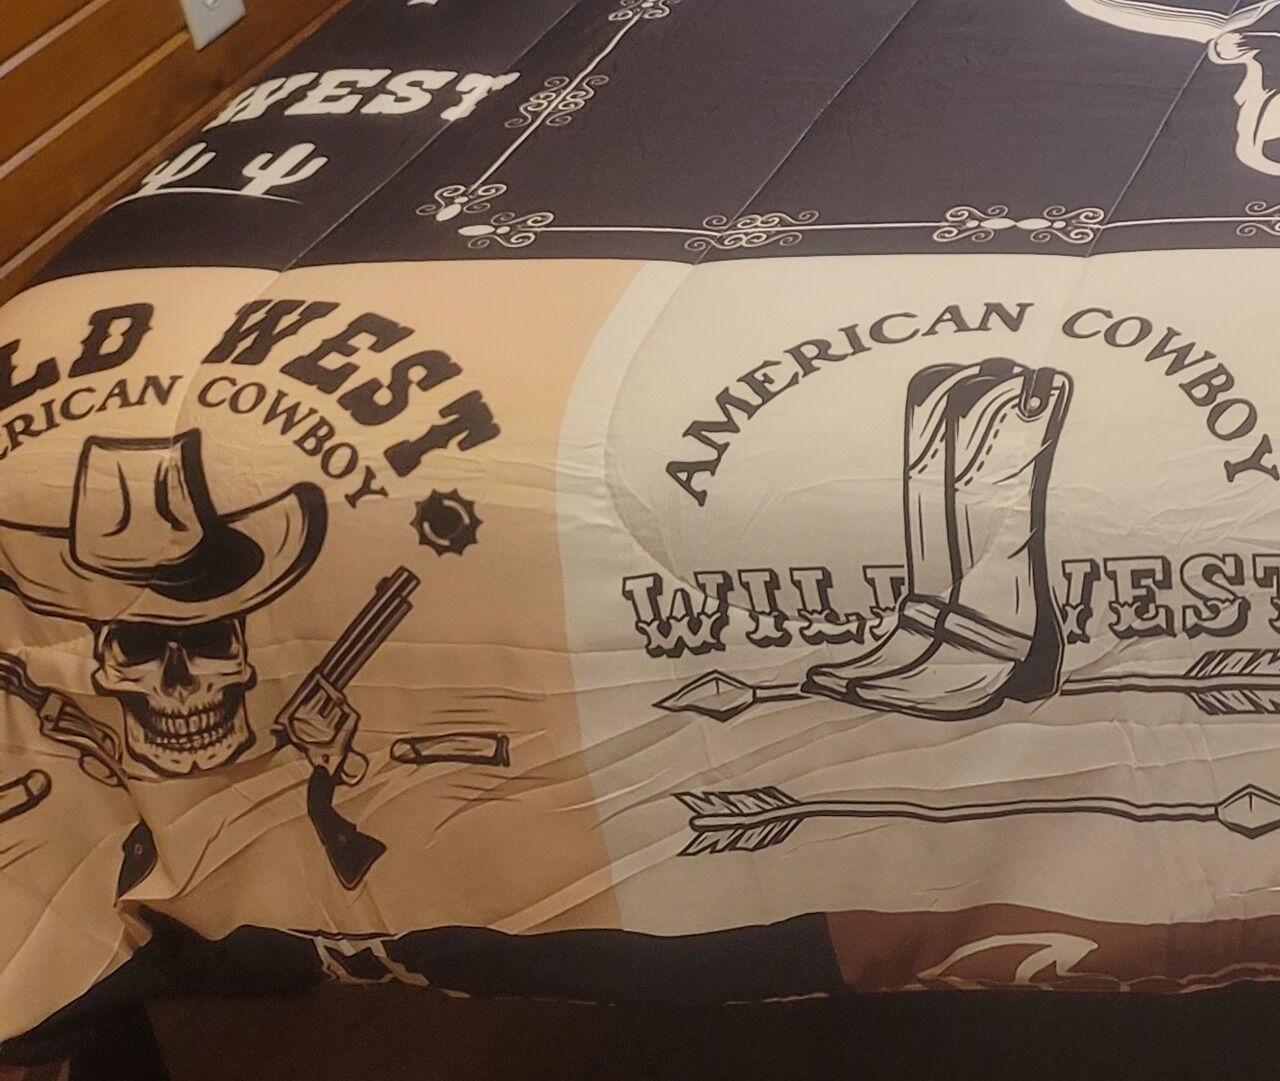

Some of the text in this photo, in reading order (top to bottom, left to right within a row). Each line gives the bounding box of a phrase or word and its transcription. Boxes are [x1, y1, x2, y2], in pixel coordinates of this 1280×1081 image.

[202, 68, 521, 133] WEST
[0, 299, 500, 477] LD WEST
[0, 375, 389, 508] RICAN COWBOY
[664, 302, 1280, 507] AMERICAN COWBOY
